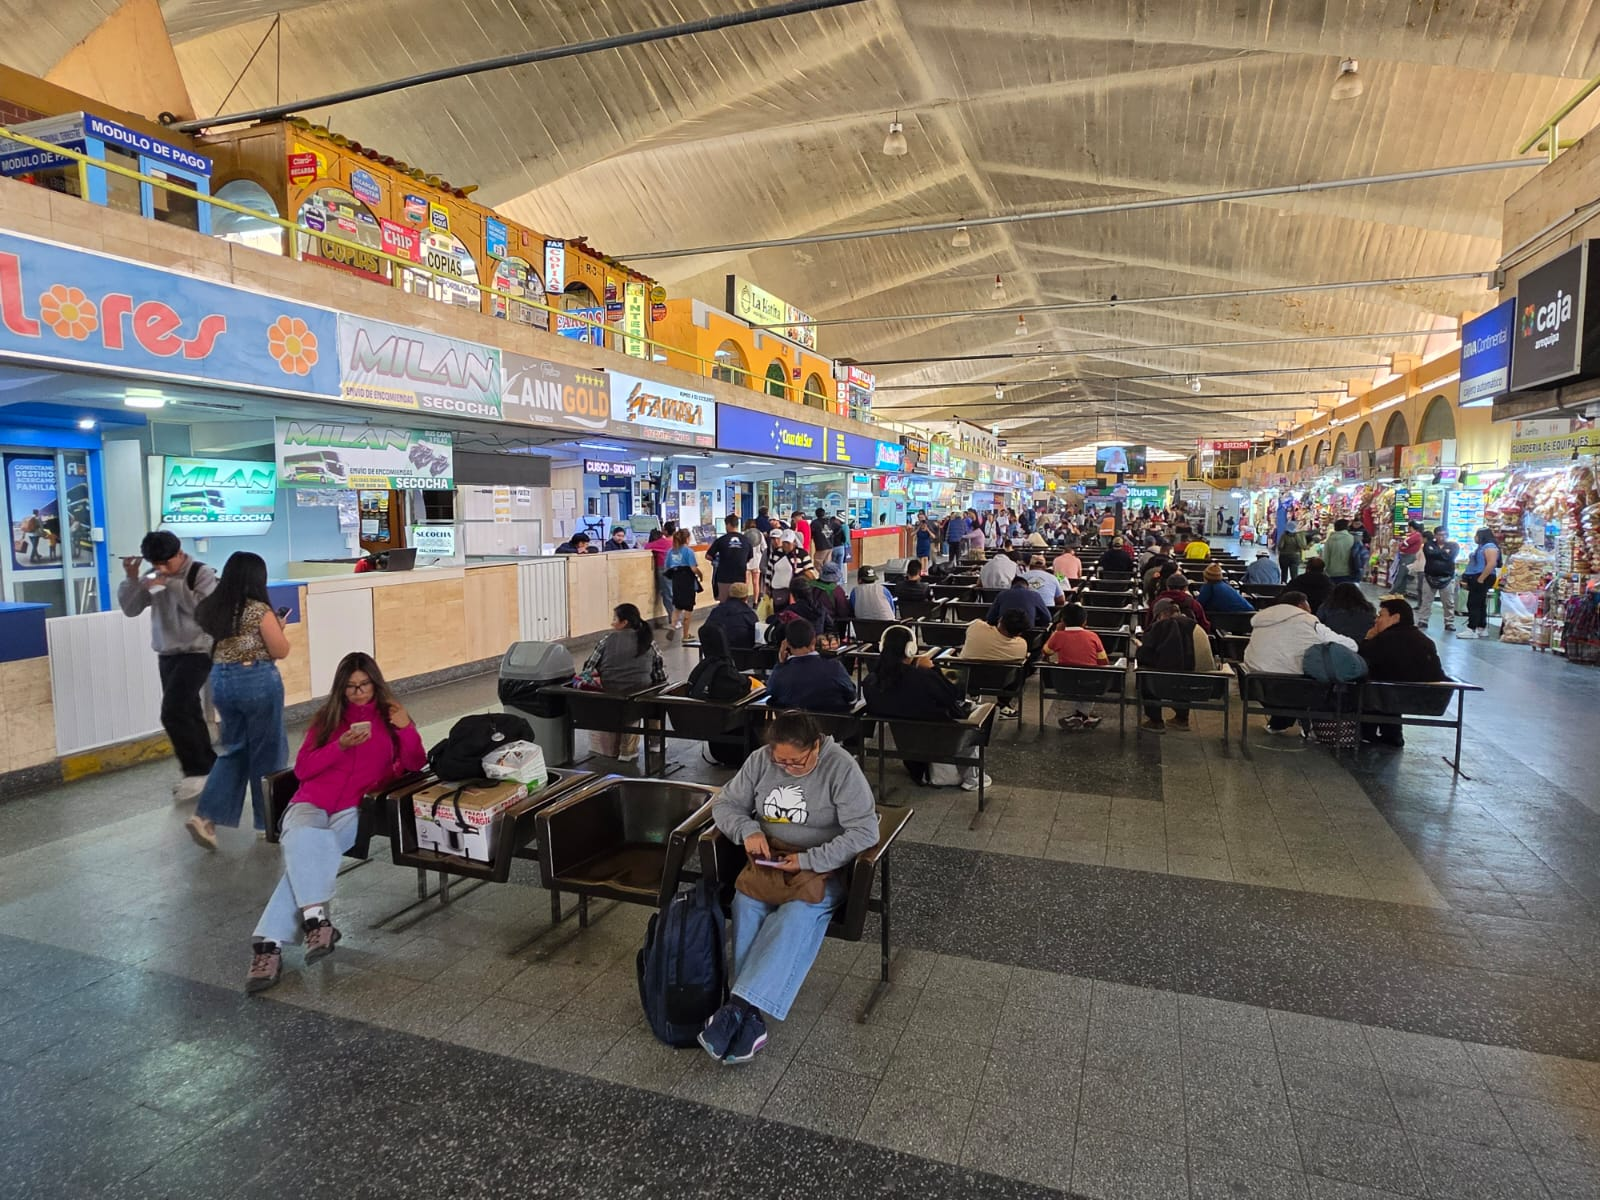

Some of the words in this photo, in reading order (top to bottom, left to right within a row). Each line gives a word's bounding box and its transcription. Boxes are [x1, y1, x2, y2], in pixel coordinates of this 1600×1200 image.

[91, 119, 150, 150] MODULO
[153, 142, 170, 158] DE
[172, 149, 206, 170] PAGO
[1, 154, 39, 172] MODULO
[41, 151, 54, 164] DE
[383, 230, 413, 251] CHIP
[546, 240, 564, 249] FAX
[320, 238, 379, 274] COPIAS
[427, 251, 462, 277] COPIAS
[549, 248, 561, 291] COPIAS
[1536, 289, 1573, 333] caja
[1477, 328, 1508, 353] Continental
[350, 328, 494, 393] MILAN
[365, 389, 373, 400] DE
[374, 390, 414, 405] ENCOMIENDAS
[422, 395, 500, 417] SECOCHA
[284, 421, 411, 452] MILAN
[1543, 441, 1551, 452] DE
[15, 470, 57, 478] DESTINO
[167, 464, 275, 489] MILAN
[586, 461, 610, 473] CUSCO
[613, 463, 636, 476] SICUANI
[395, 477, 449, 489] SECOCHA
[163, 514, 208, 523] CUSCO
[217, 513, 272, 522] SECOCHA
